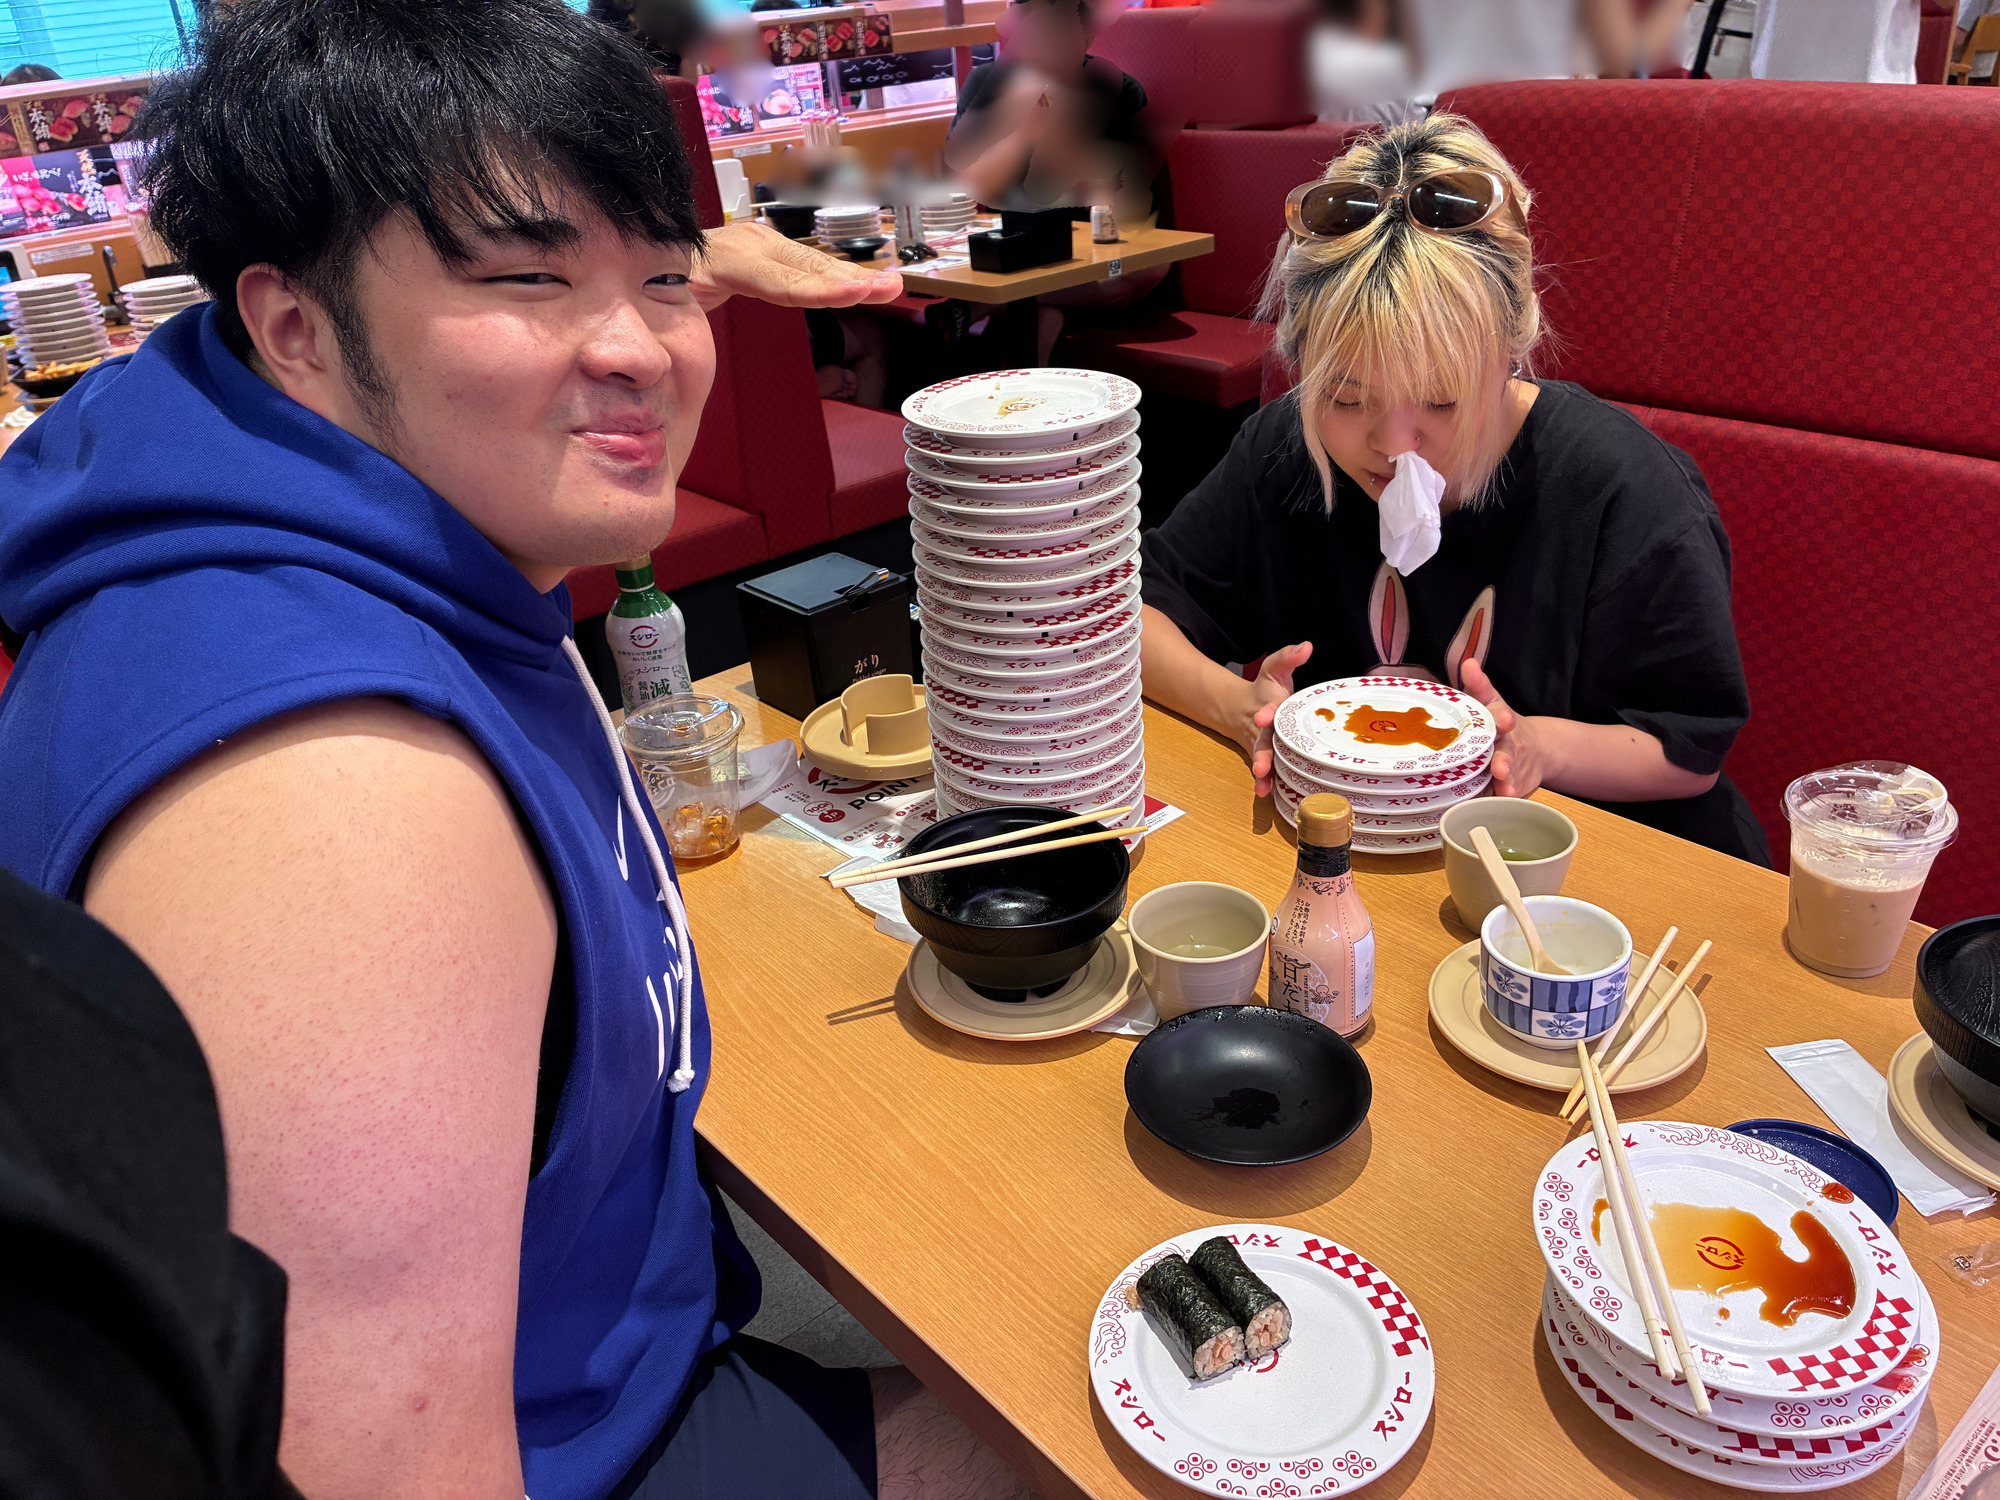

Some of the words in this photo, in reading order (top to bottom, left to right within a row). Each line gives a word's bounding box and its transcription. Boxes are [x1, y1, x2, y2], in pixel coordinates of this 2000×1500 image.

[1042, 412, 1095, 426] スシロー
[951, 498, 1007, 506] スシロー
[932, 515, 977, 528] スシロー
[1095, 520, 1125, 540] スシロー
[1086, 546, 1120, 567] スシロー
[956, 612, 1010, 623] スシロー
[629, 633, 660, 641] スシロー
[969, 636, 1022, 645] スシロー
[635, 666, 670, 675] スシロー
[854, 654, 879, 674] がり
[1001, 660, 1060, 668] スシロー
[953, 675, 1002, 688] スシロー
[1306, 681, 1347, 698] スシロー
[992, 704, 1050, 712] スシロー
[948, 712, 993, 727] スシロー
[1048, 735, 1098, 751] スシロー
[1322, 751, 1379, 764] スシロー
[963, 777, 1012, 791] スシロー
[1336, 773, 1393, 784] スシロー
[771, 782, 794, 794] NEW!
[1387, 795, 1440, 806] スシロー
[1355, 816, 1402, 825] シロー
[1396, 832, 1441, 844] スシロ
[1577, 1133, 1639, 1168] スロー
[1226, 1233, 1283, 1248] スシロ
[1849, 1210, 1900, 1279] スシロー
[1695, 1243, 1747, 1265] スシロー
[1110, 1378, 1166, 1442] スシロー
[1373, 1371, 1412, 1442] スシロー
